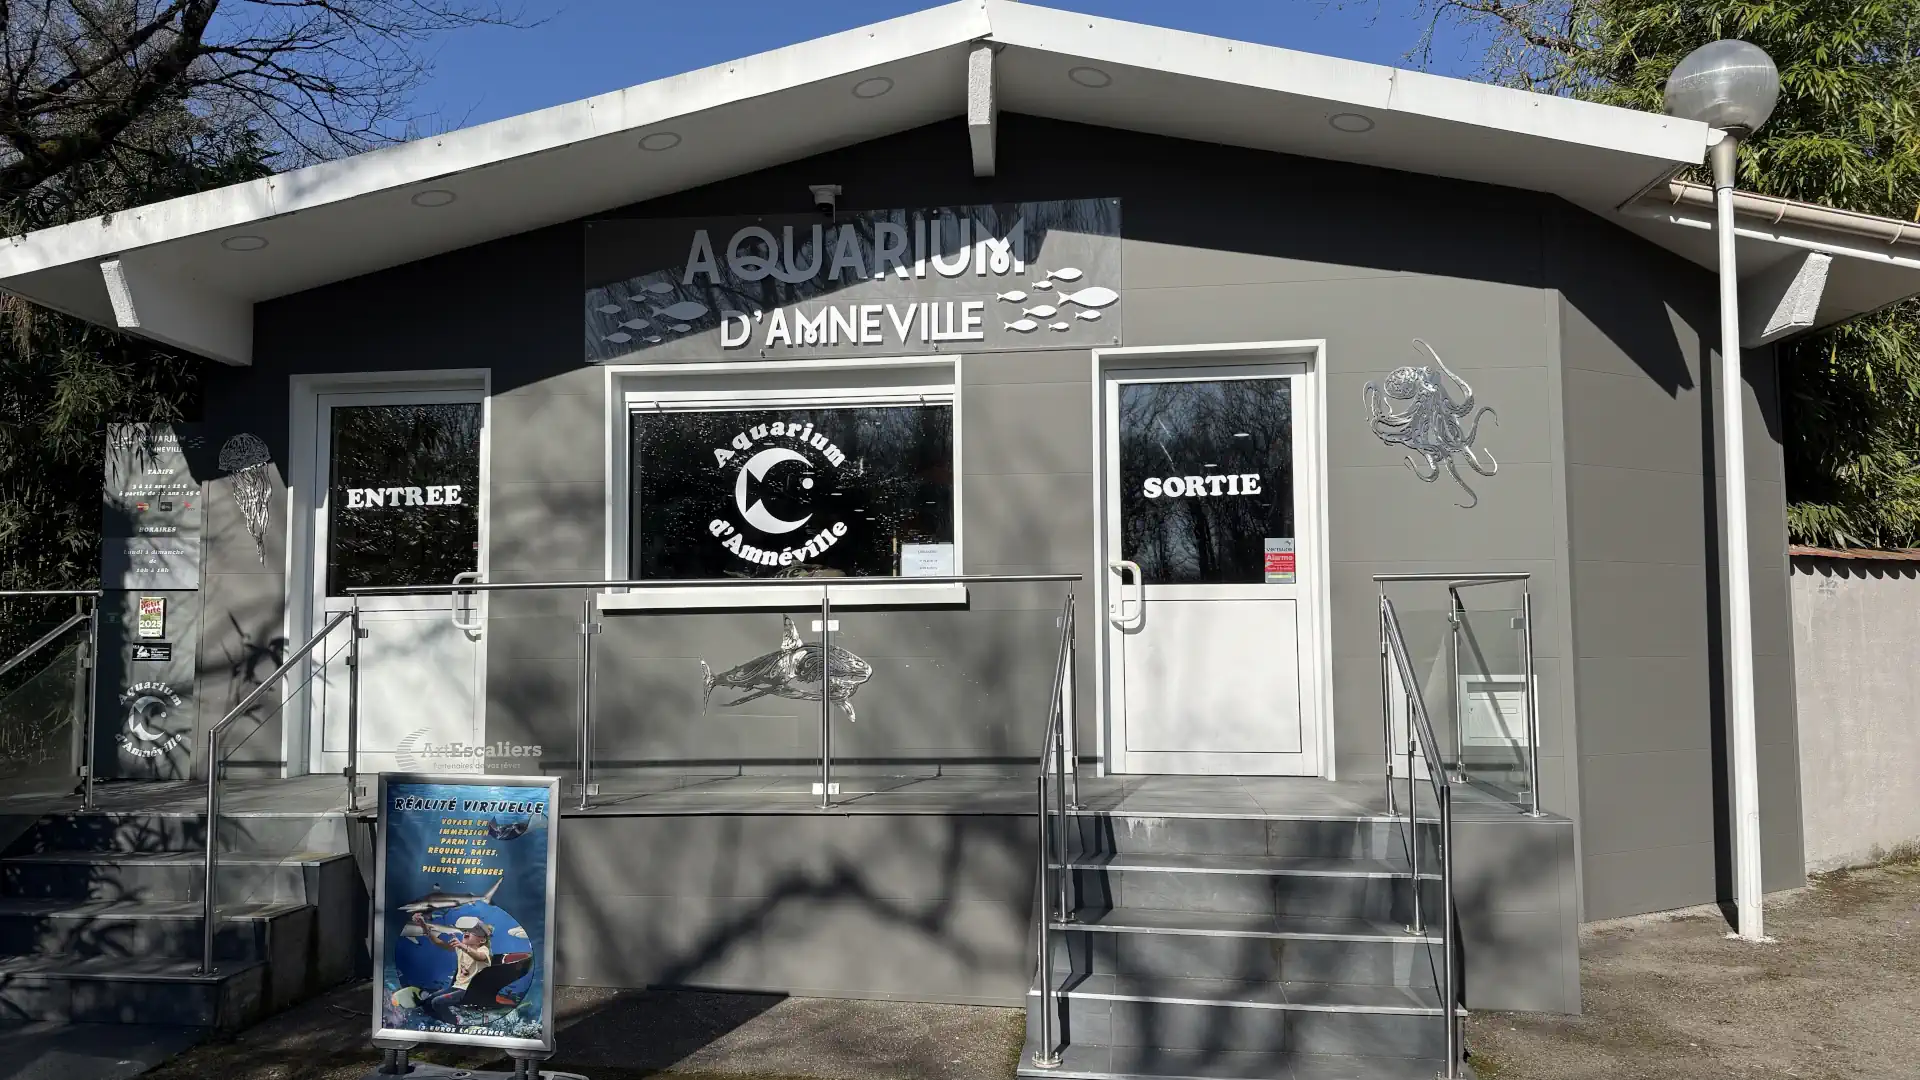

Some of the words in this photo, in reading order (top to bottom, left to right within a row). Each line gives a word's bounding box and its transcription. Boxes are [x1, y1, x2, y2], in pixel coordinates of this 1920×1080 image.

[682, 216, 1026, 285] AQUARIUM
[720, 301, 985, 348] D'AMNEVILLE
[713, 421, 846, 468] Aquarium
[1143, 473, 1262, 498] SORTIE
[346, 485, 463, 508] ENTREE
[708, 518, 848, 567] d'Amnéville
[139, 620, 161, 628] 2025
[118, 681, 182, 706] Aquarium
[114, 733, 182, 758] d'Amnéville
[420, 741, 543, 758] ArtEscaliers
[395, 795, 457, 812] RÉALITÉ
[463, 799, 545, 814] VIRTUELLE
[441, 818, 474, 826] VOYAGE
[439, 828, 489, 836] IMMERSION
[440, 837, 469, 845] PARMI
[471, 838, 487, 846] LES
[428, 847, 467, 856] REQUINS,
[470, 848, 499, 857] RAIES,
[422, 865, 460, 875] PIEUVRE,
[463, 865, 504, 876] MÉDUSES
[440, 857, 484, 866] BALEINES,
[429, 1025, 457, 1033] EUROS
